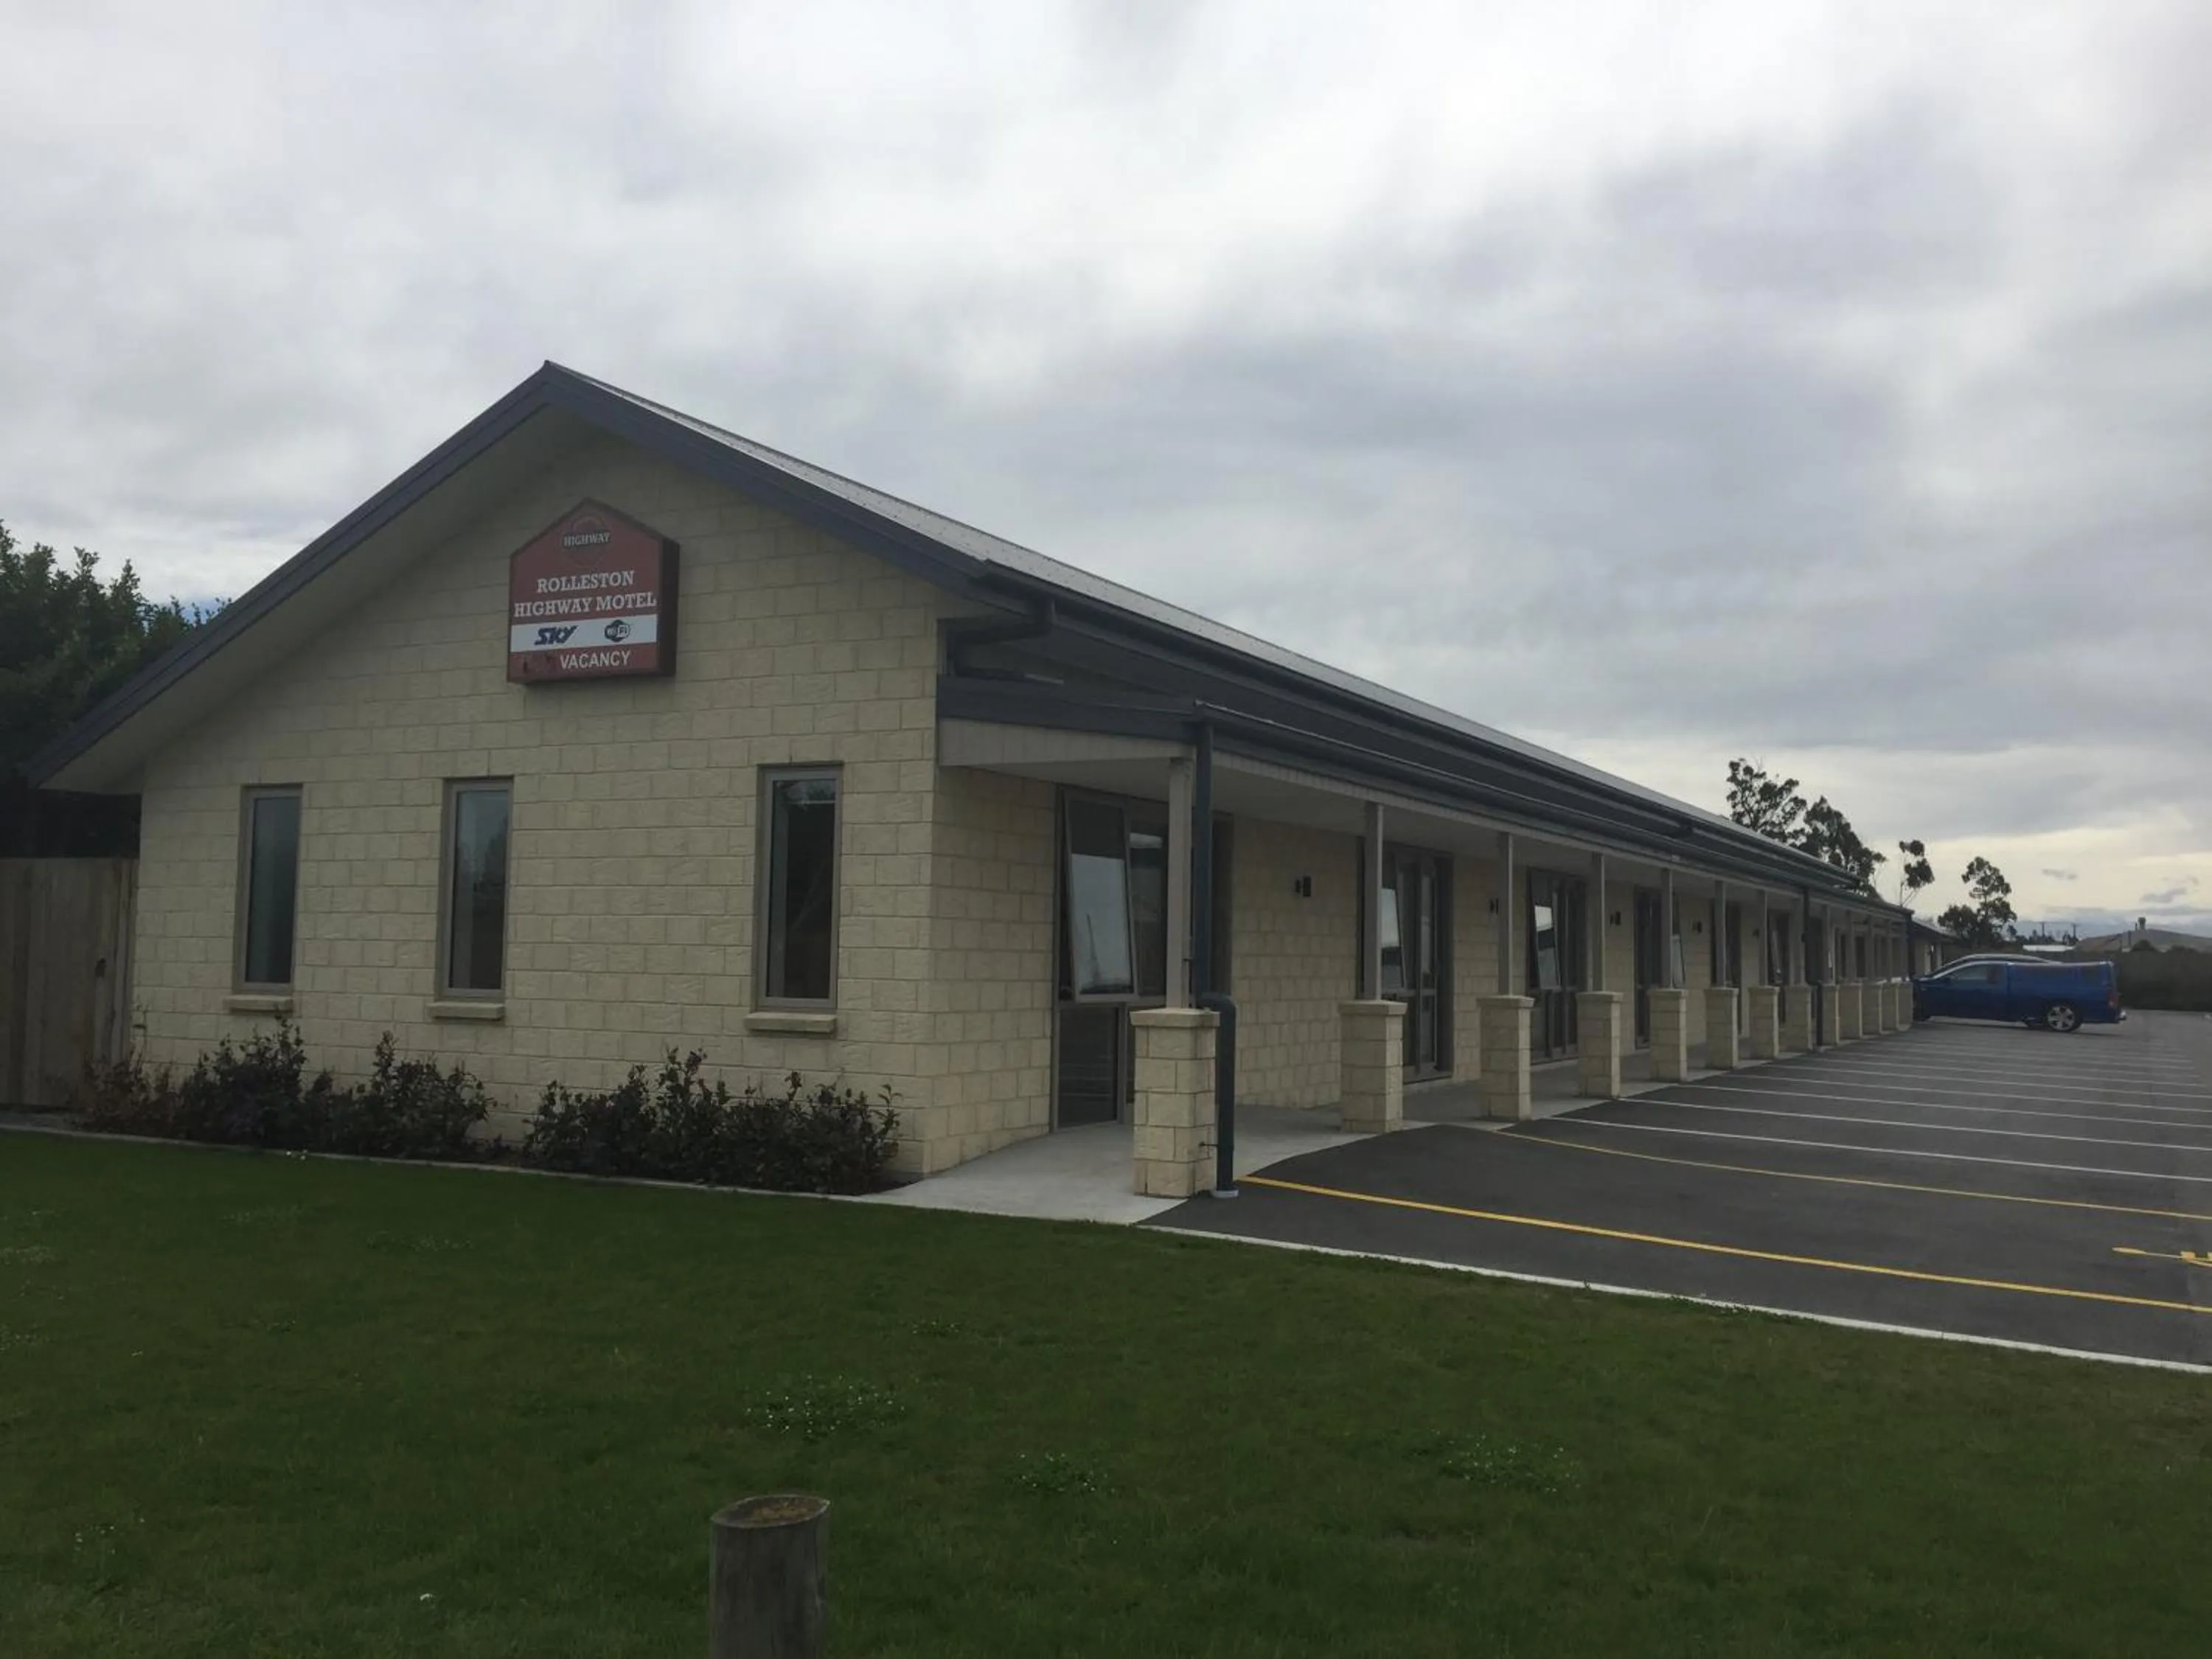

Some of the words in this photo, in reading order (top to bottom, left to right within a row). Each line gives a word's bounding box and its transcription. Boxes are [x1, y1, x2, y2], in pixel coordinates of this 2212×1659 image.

[563, 532, 610, 546] HIGHWAY
[537, 570, 635, 593] ROLLESTON
[514, 597, 592, 617] HIGHWAY
[596, 591, 657, 611] MOTEL
[534, 625, 578, 645] SKY
[560, 650, 630, 669] VACANCY
